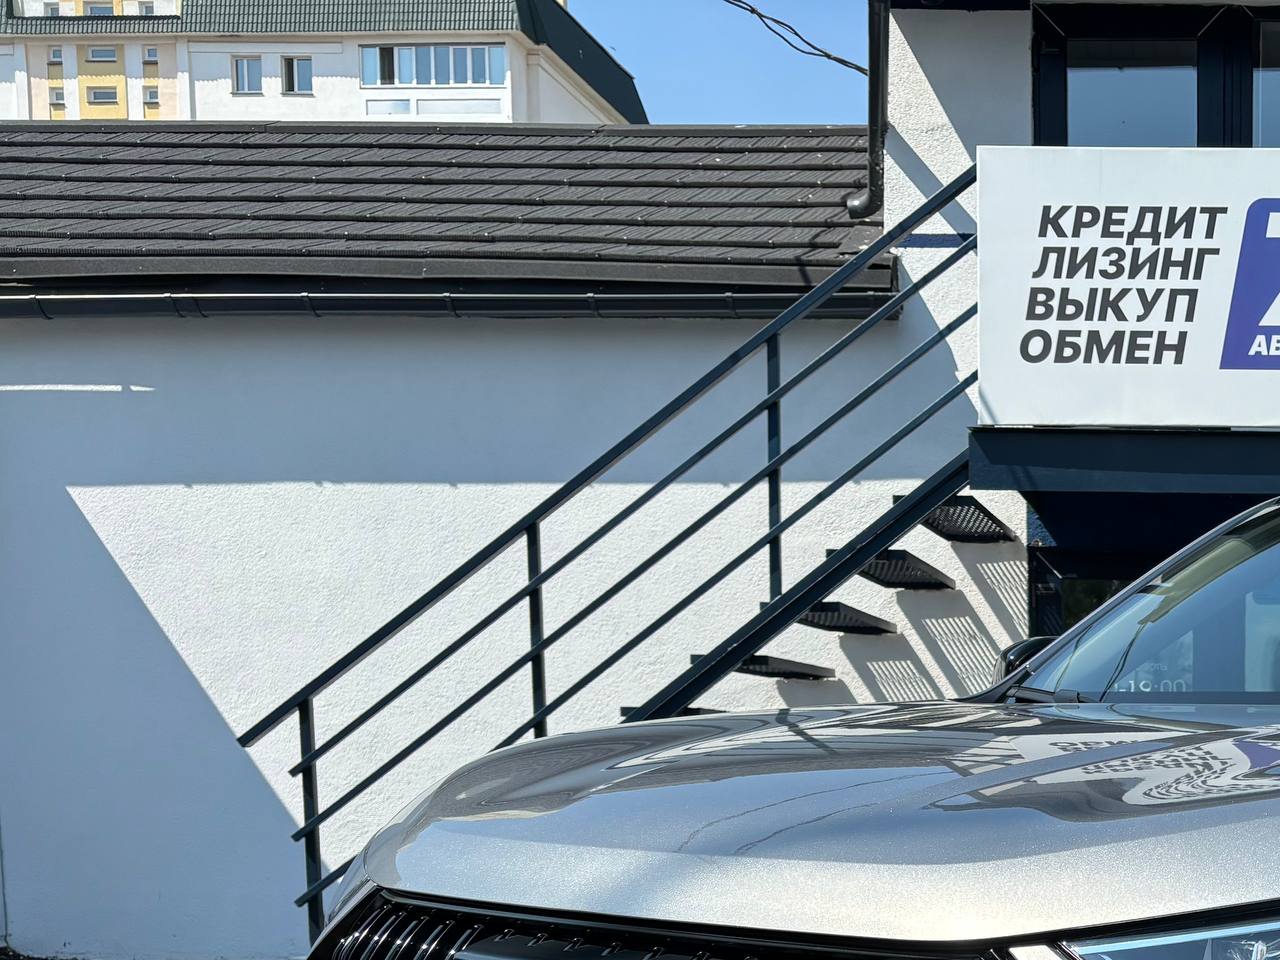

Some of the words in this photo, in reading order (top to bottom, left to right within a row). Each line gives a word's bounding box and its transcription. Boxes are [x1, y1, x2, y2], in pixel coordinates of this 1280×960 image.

[1037, 205, 1229, 246] КРЕДИТ
[1031, 246, 1221, 281] ЛИЗИНГ
[1025, 287, 1199, 323] ВЫКУП
[1019, 328, 1188, 365] ОБМЕН
